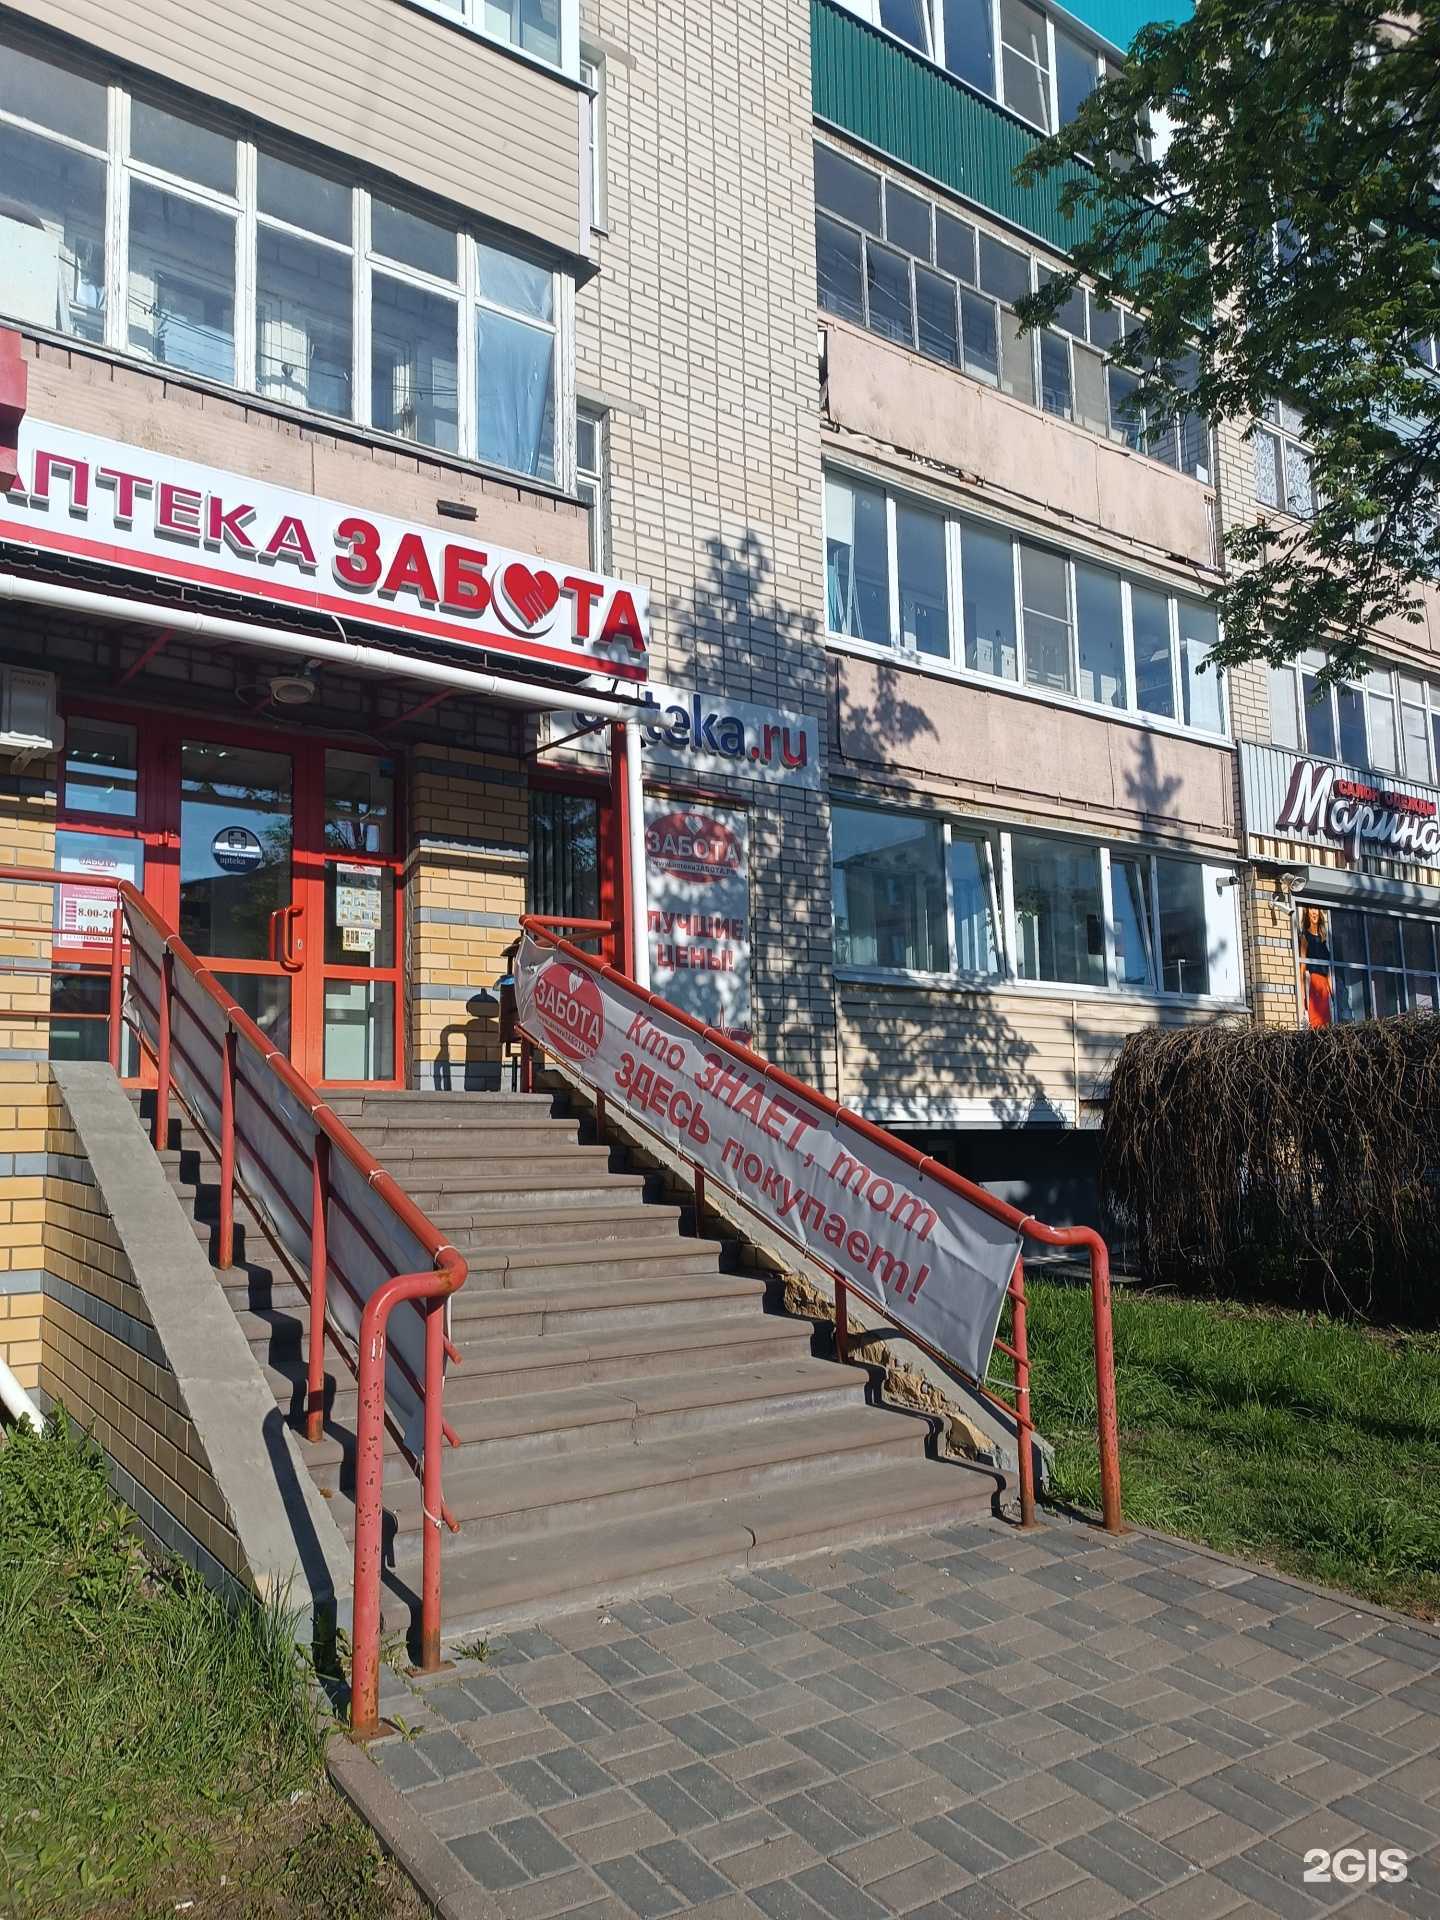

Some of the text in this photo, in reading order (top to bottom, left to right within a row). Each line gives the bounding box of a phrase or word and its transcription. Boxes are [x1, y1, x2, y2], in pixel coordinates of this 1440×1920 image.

[4, 449, 319, 576] ПТЕКА
[574, 691, 808, 767] teka.ru
[1276, 761, 1440, 860] Марина
[1384, 792, 1436, 817] ОДЕЖДЫ
[646, 831, 738, 862] ЗАБОТА
[648, 911, 744, 941] ЛУЧШИЕ
[657, 944, 734, 973] ЦЕНЫ!
[536, 978, 601, 1046] ЗАБОТА
[625, 1009, 938, 1242] Кто ЗНАЕТ, тот
[614, 1053, 930, 1304] ЗДЕСЬ покупает!
